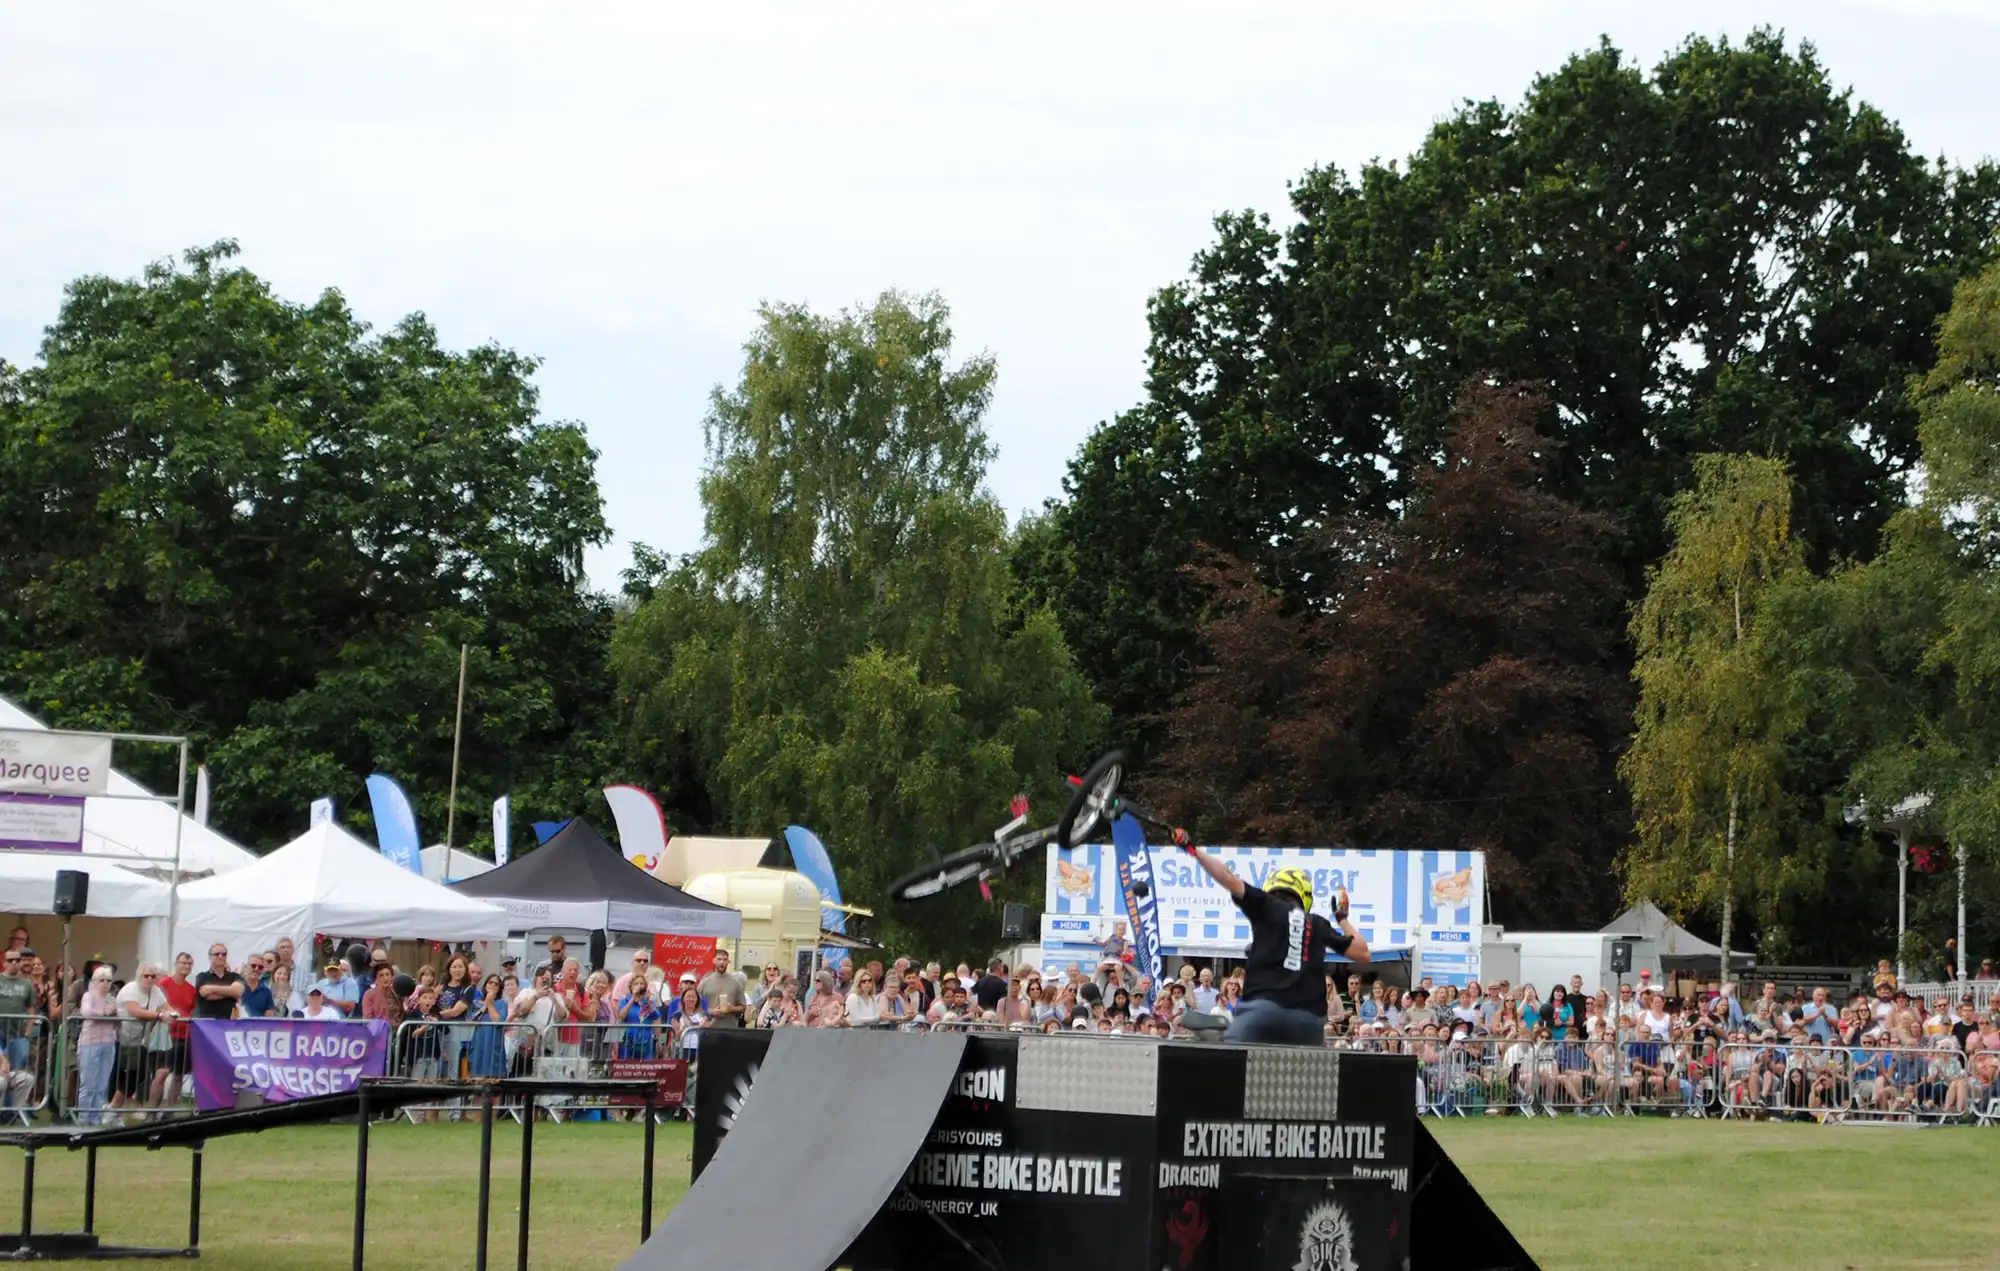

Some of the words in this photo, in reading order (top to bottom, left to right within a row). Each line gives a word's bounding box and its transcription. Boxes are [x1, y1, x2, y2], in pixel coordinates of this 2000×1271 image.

[1249, 860, 1359, 897] Vgar
[1060, 921, 1082, 930] MENU
[1440, 932, 1461, 941] MENU
[227, 1032, 289, 1057] BBC
[296, 1035, 367, 1060] RADIO
[929, 1129, 1003, 1148] ERISYOURS
[1183, 1122, 1272, 1157] EXTREME
[1275, 1124, 1317, 1158] BIKE
[1318, 1125, 1386, 1159] BATTLE
[983, 1153, 1033, 1192] BIKE
[1036, 1157, 1122, 1197] BATTLE
[1158, 1161, 1220, 1189] DRAGON
[1310, 1242, 1342, 1264] BIKE
